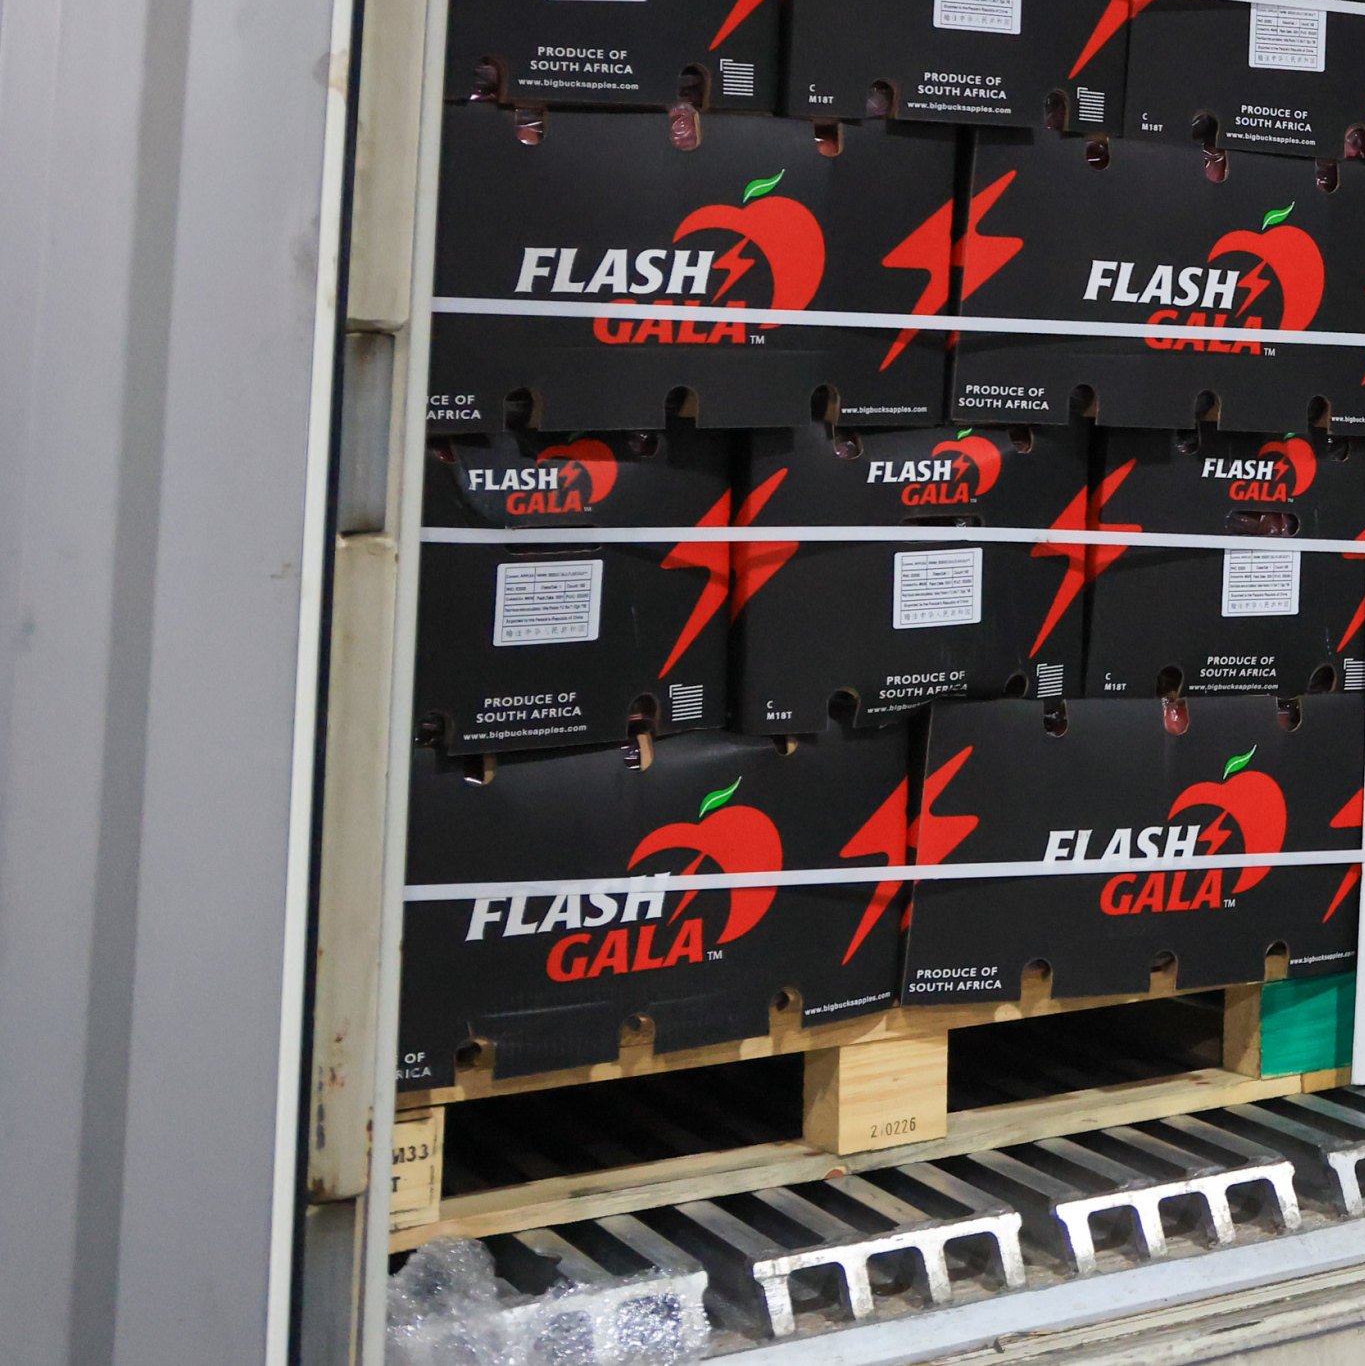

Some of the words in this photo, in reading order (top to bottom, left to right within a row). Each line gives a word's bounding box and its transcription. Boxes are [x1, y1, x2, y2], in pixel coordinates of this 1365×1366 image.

[537, 47, 603, 60] PRODUCE
[610, 50, 627, 59] OF
[530, 60, 581, 73] SOUTH
[584, 62, 633, 74] AFRICA
[518, 79, 639, 91] www.bigbucksapples.com
[515, 247, 715, 295] FLASH
[1083, 260, 1240, 310] FLASH
[593, 300, 747, 345] GALA
[469, 468, 558, 491] FLASH
[867, 459, 952, 483] FLASH
[1202, 457, 1275, 480] FLASH
[901, 482, 969, 505] GALA
[1229, 480, 1287, 502] GALA
[506, 492, 581, 515] GALA
[465, 871, 671, 941] FLASH
[546, 919, 704, 982] GALA
[916, 968, 975, 979] PRODUCE
[980, 967, 998, 978] OF
[909, 980, 954, 992] SOUTH
[958, 979, 1002, 991] AFRICA
